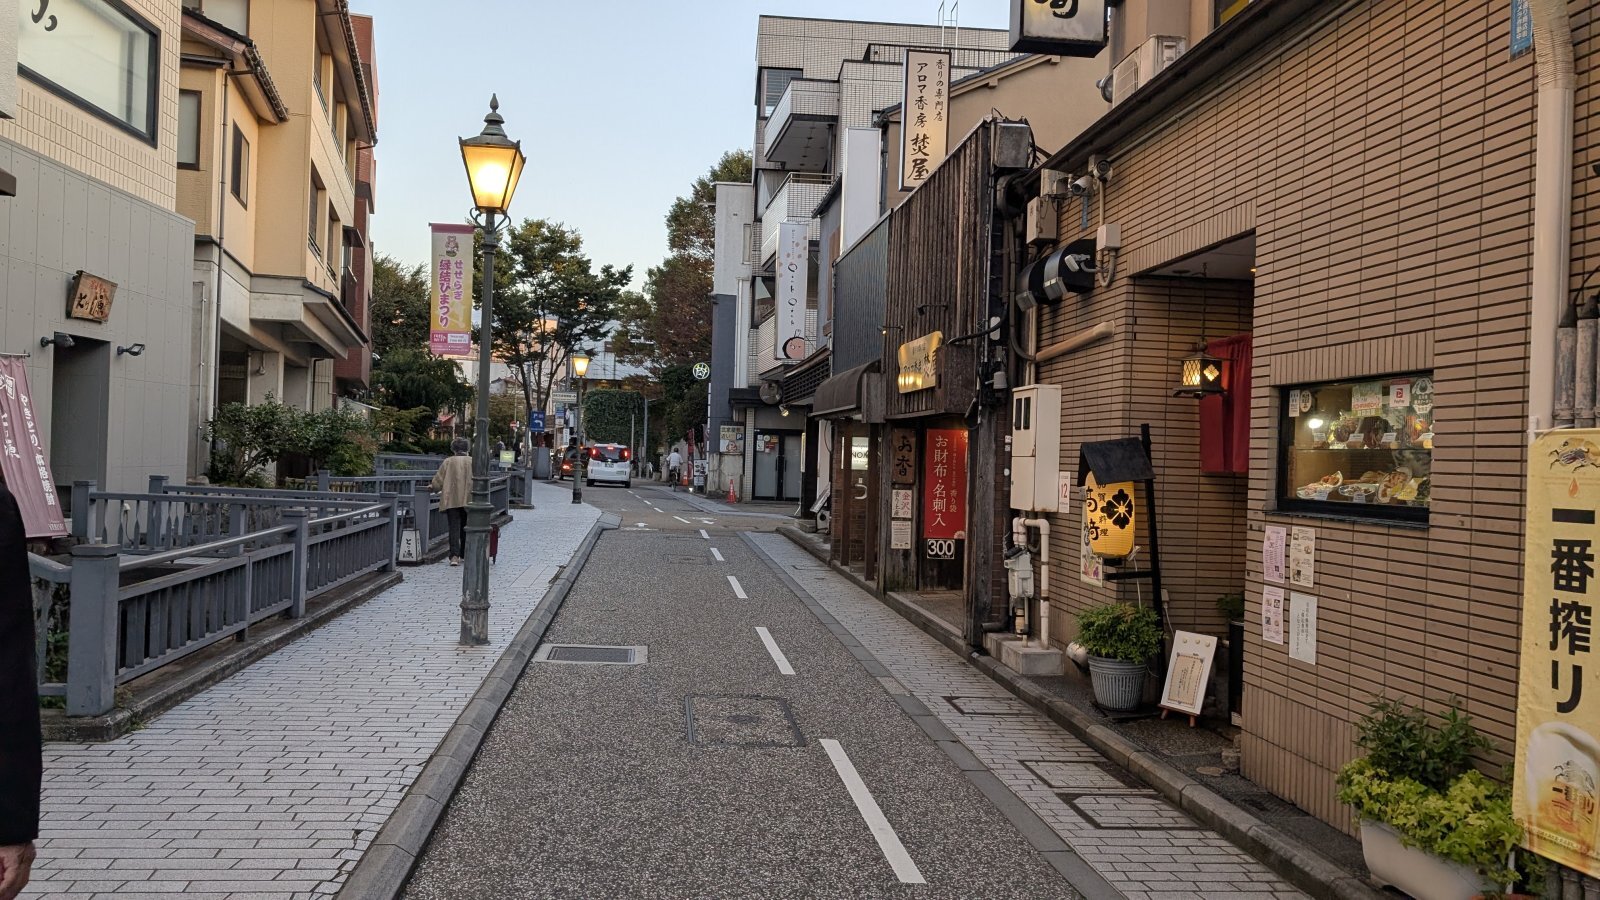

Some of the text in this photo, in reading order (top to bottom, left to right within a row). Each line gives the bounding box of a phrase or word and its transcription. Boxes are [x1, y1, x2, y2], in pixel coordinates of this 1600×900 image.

[933, 59, 946, 122] 香りの専門店
[907, 62, 930, 180] アロマ香房 焚屋
[439, 259, 451, 328] 縁結びまつり
[454, 260, 463, 300] せせらぎ
[896, 435, 912, 477] お香
[931, 435, 949, 527] お財布・名刺入
[901, 491, 911, 516] 金沢の
[928, 540, 954, 555] 300
